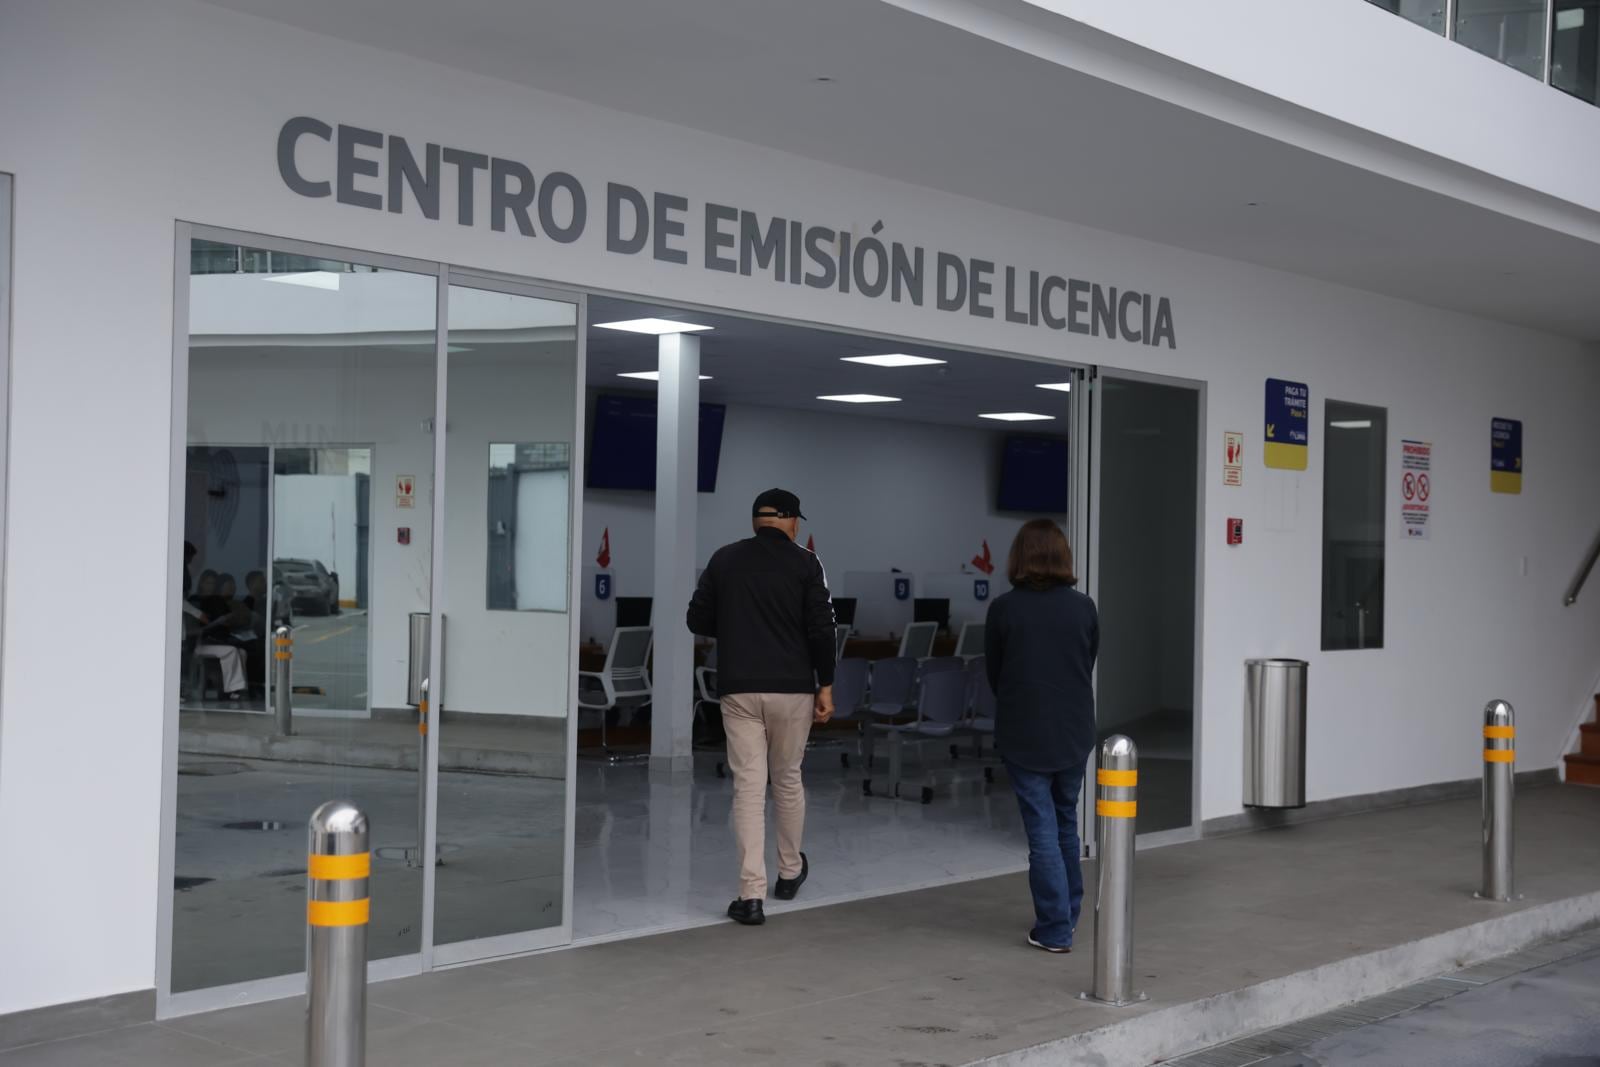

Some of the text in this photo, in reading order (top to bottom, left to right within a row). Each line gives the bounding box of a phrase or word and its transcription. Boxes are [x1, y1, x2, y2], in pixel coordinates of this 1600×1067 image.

[277, 116, 1176, 349] CENTRO DE EMISIÓN DE LICENCIA
[599, 579, 606, 595] 6
[898, 582, 905, 596] 9
[976, 583, 987, 597] 10
